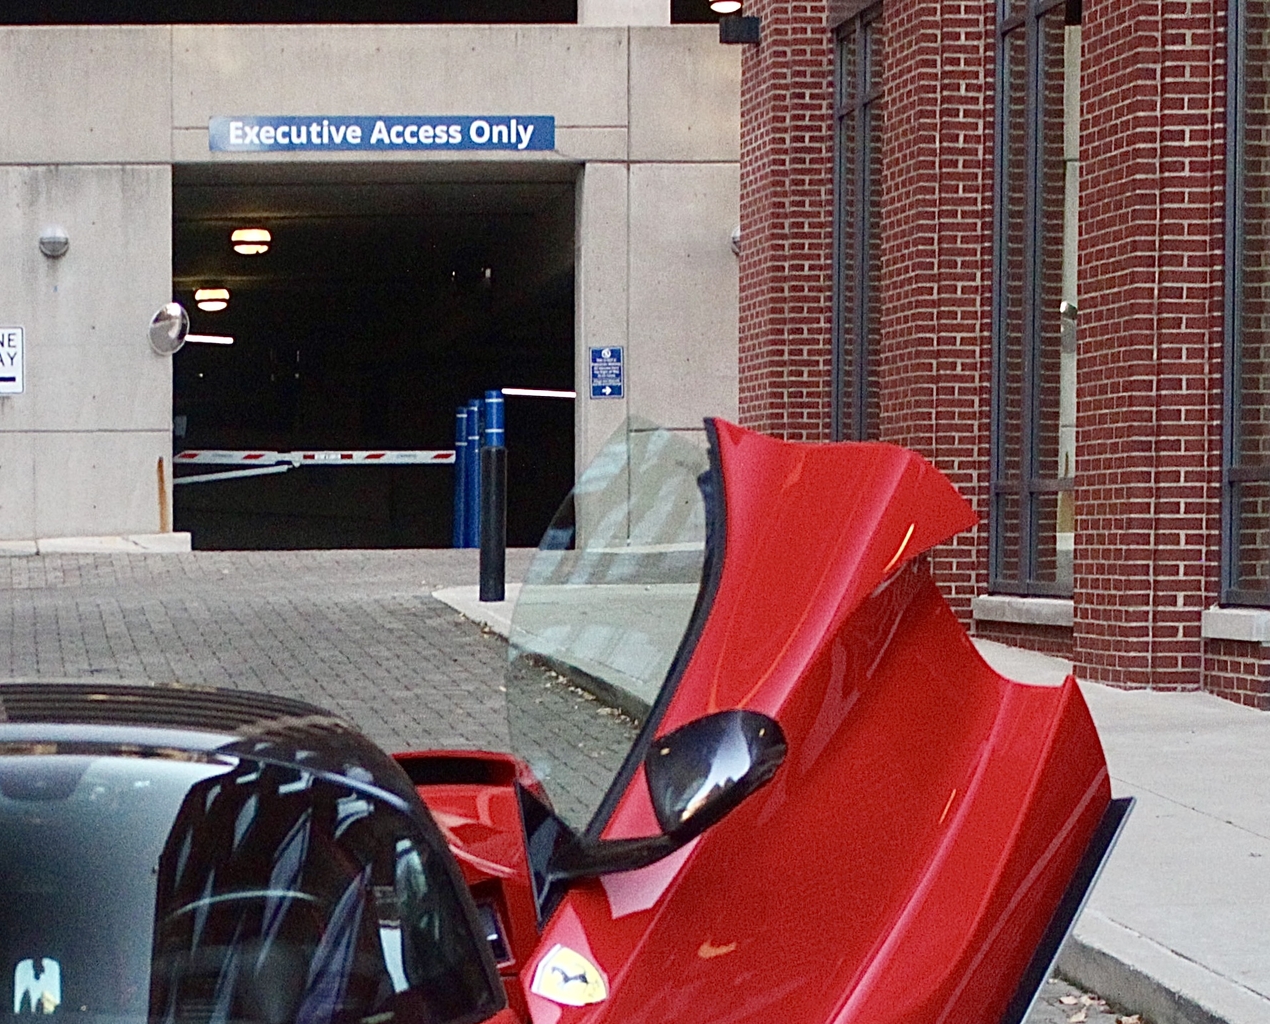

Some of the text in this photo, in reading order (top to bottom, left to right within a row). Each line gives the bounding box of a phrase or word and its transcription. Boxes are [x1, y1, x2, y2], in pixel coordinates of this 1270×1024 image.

[230, 120, 534, 149] Executive Access Only
